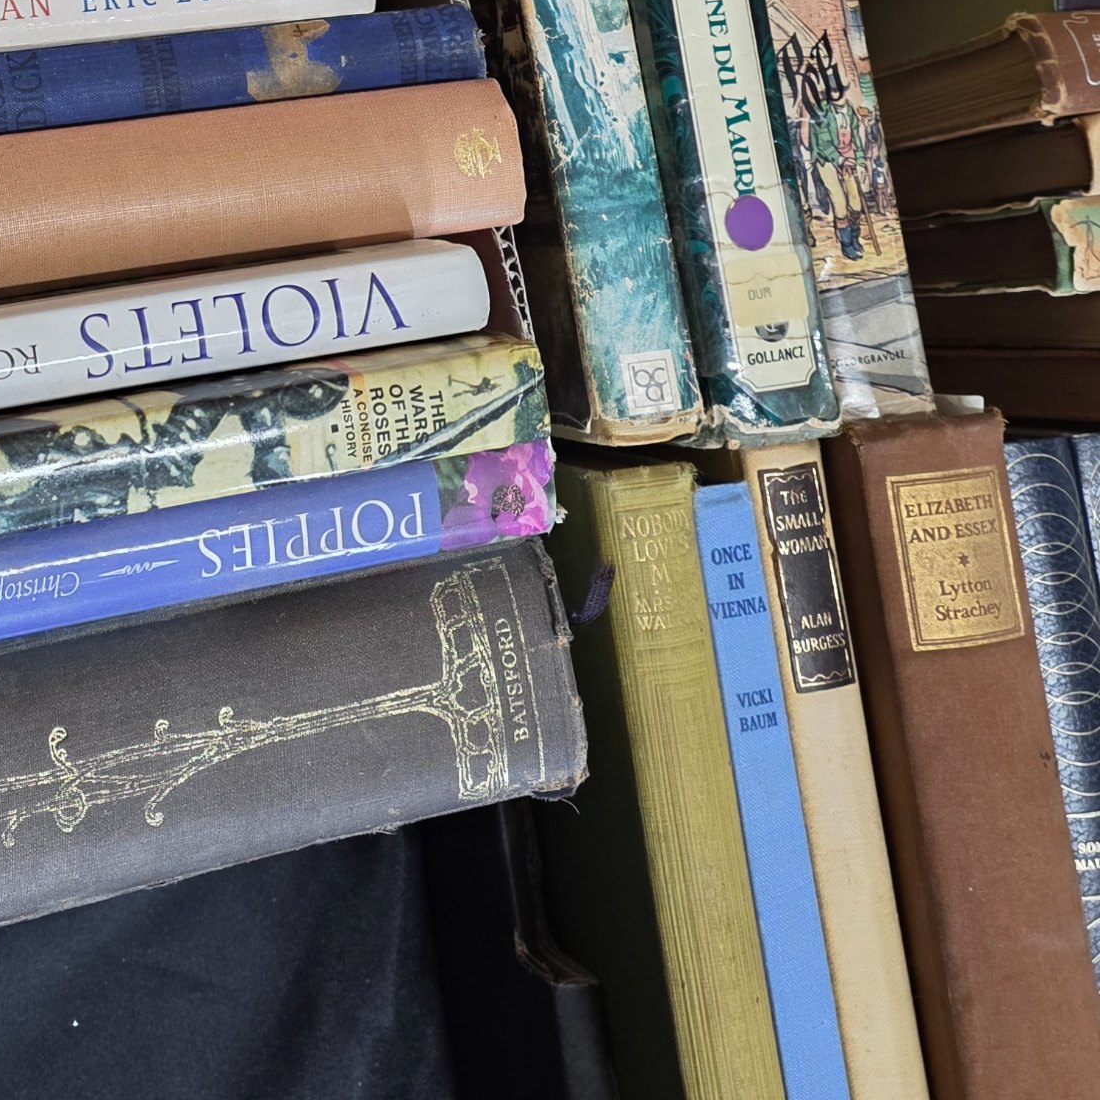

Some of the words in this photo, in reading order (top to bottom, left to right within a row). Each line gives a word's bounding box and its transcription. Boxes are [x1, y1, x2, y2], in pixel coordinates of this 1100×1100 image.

[714, 43, 738, 89] DU
[6, 51, 48, 131] DICK
[748, 287, 772, 301] DUM
[80, 272, 410, 380] VIOLETS
[747, 346, 806, 366] GOLLANCZ
[353, 388, 364, 398] A
[389, 384, 406, 410] OF
[369, 387, 392, 455] ROSES
[409, 385, 430, 444] WARS
[429, 390, 447, 433] THE
[341, 399, 357, 458] HISTORY
[357, 401, 373, 463] CONCISE
[904, 494, 993, 519] ELIZABETH
[776, 513, 821, 531] SMALL
[909, 523, 951, 544] AND
[954, 518, 998, 538] ESSEX
[198, 492, 427, 578] POPPIES
[777, 535, 829, 555] WOMAN
[710, 544, 752, 565] ONCE
[727, 572, 745, 590] IN
[939, 578, 993, 599] Lytton
[708, 597, 767, 620] VIENNA
[935, 602, 1002, 623] Strachey
[801, 612, 832, 629] ALAN
[793, 633, 846, 654] BURGESS
[495, 618, 530, 743] BATSFORD
[735, 689, 773, 708] VICKI
[739, 712, 779, 732] BAUM
